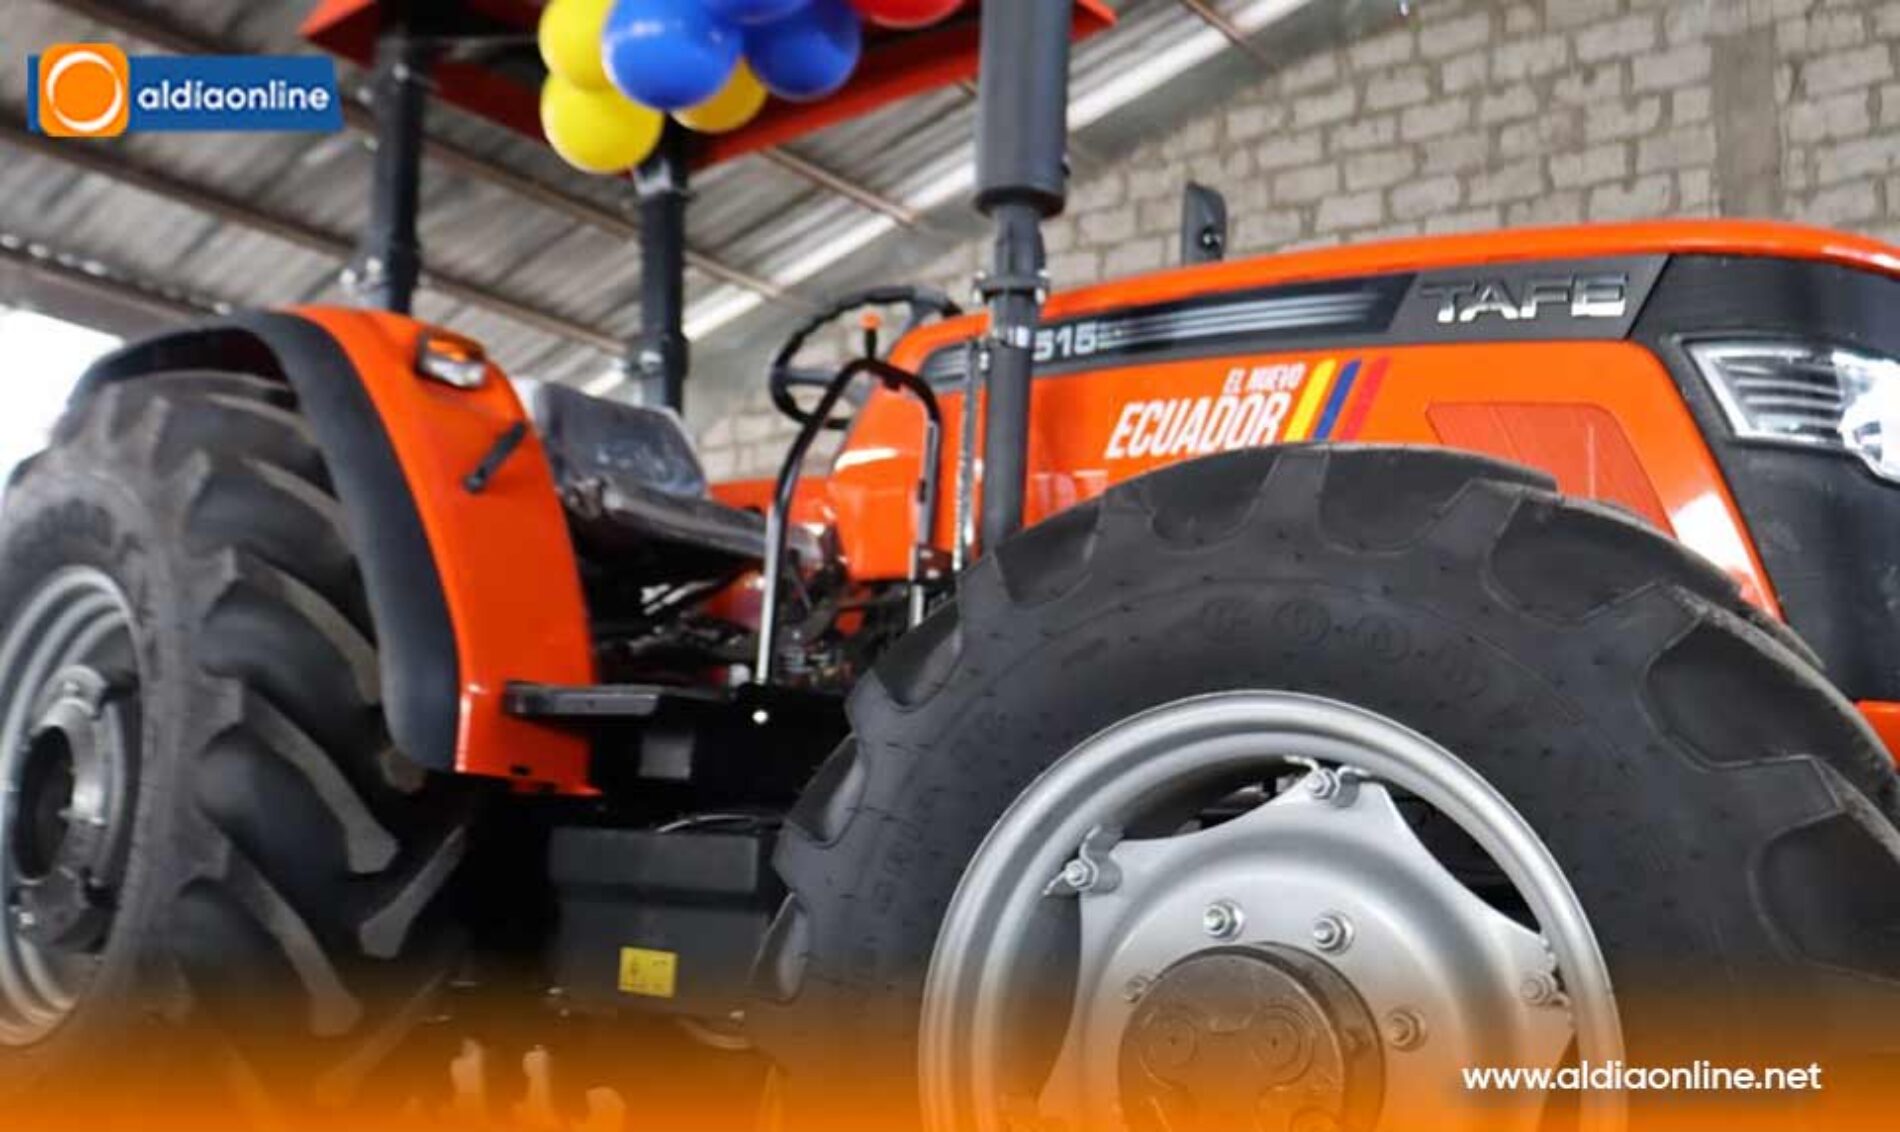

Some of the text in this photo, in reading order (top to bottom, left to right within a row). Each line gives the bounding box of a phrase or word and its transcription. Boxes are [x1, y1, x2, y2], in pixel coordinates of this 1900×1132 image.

[1420, 274, 1627, 323] TAFE
[1222, 367, 1246, 395] EL
[1104, 392, 1292, 459] ECUADOR
